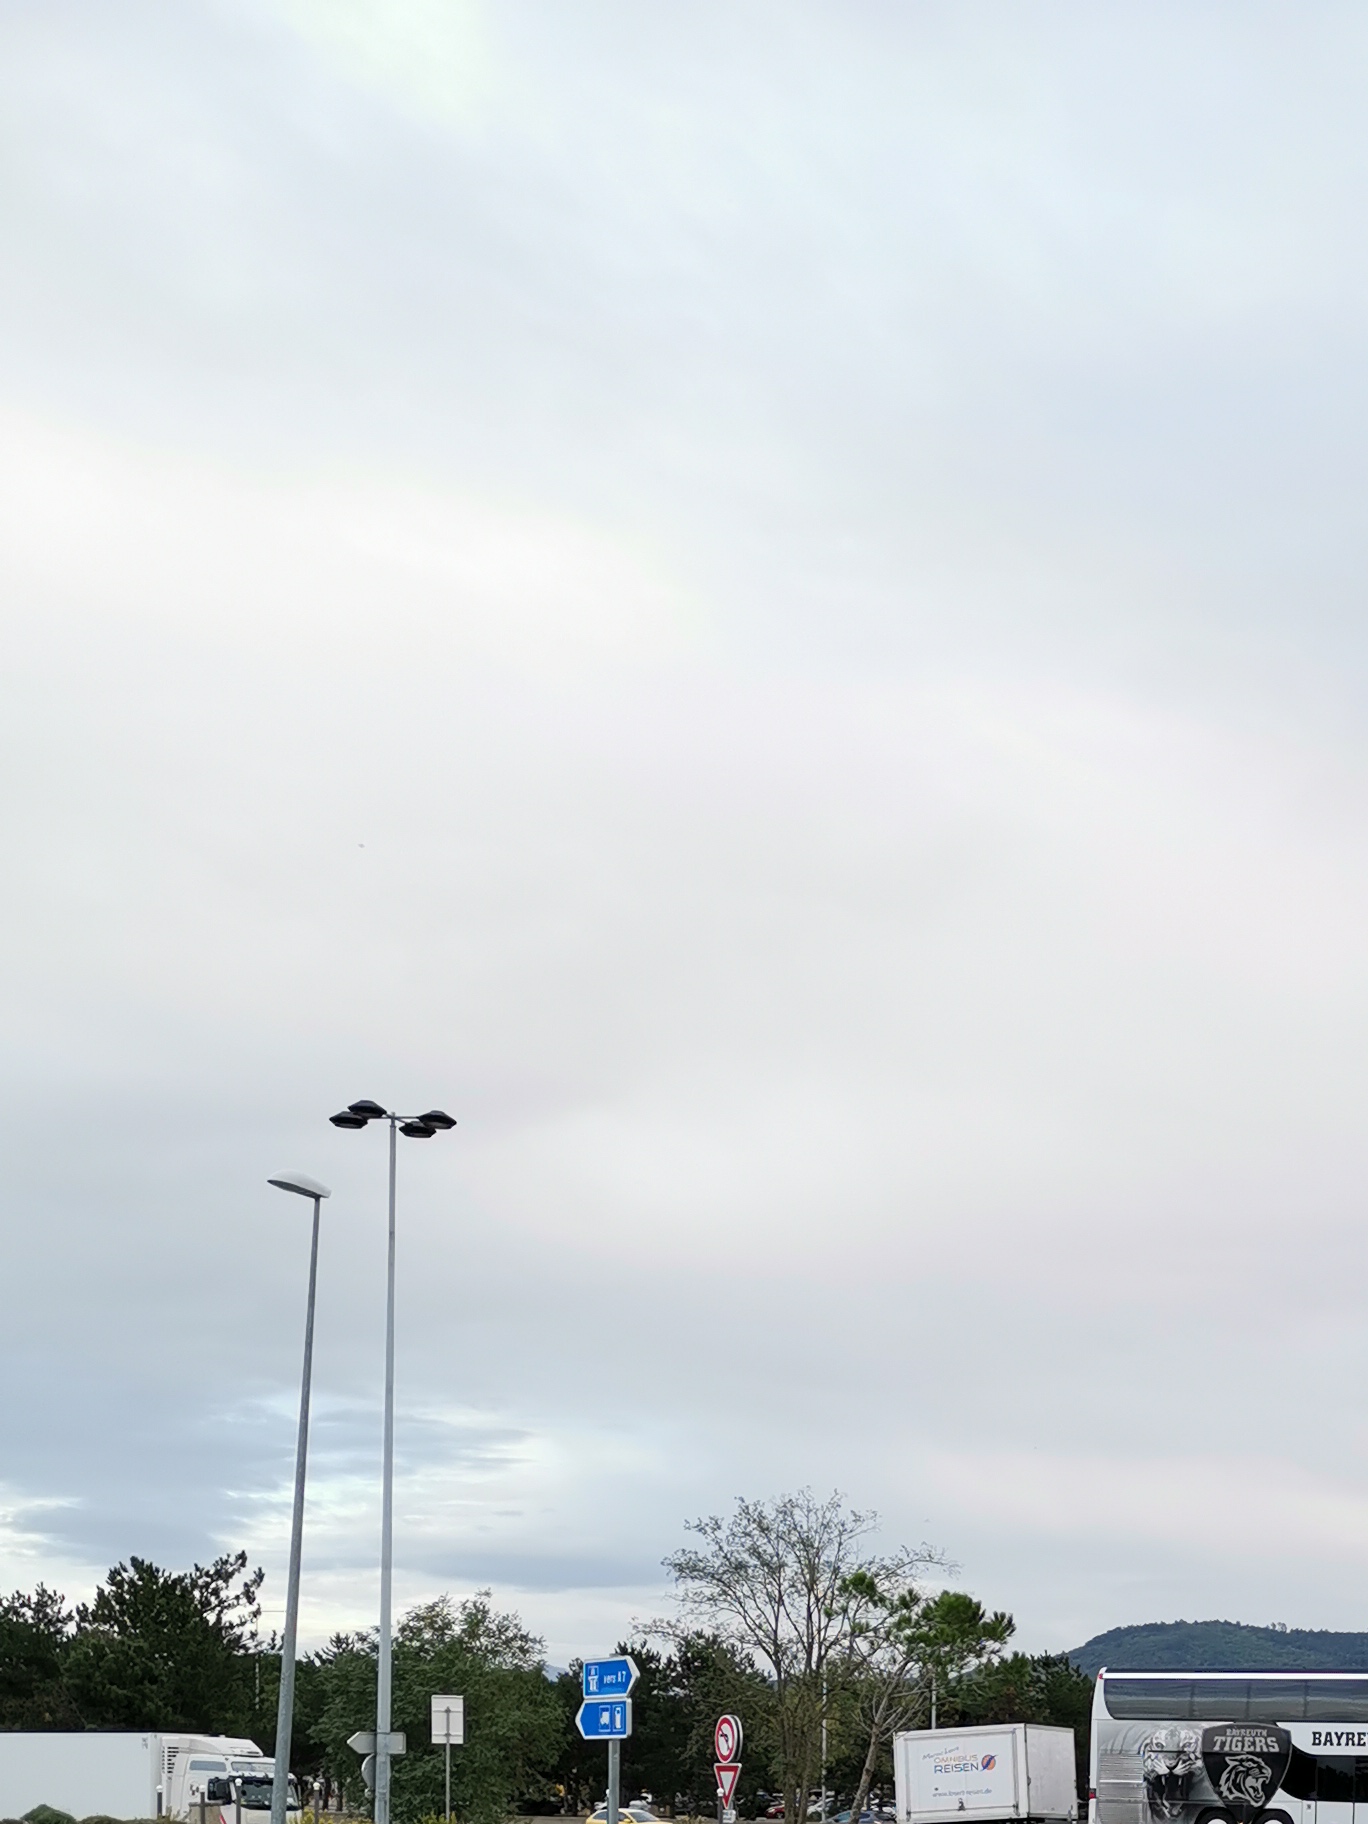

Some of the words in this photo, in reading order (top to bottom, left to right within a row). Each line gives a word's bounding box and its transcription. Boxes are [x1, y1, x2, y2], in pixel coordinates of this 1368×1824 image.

[1226, 1728, 1268, 1737] BAYREUTH
[1213, 1736, 1280, 1752] TIGERS
[934, 1754, 979, 1763] OMNIBUS
[934, 1762, 979, 1774] REISEN
